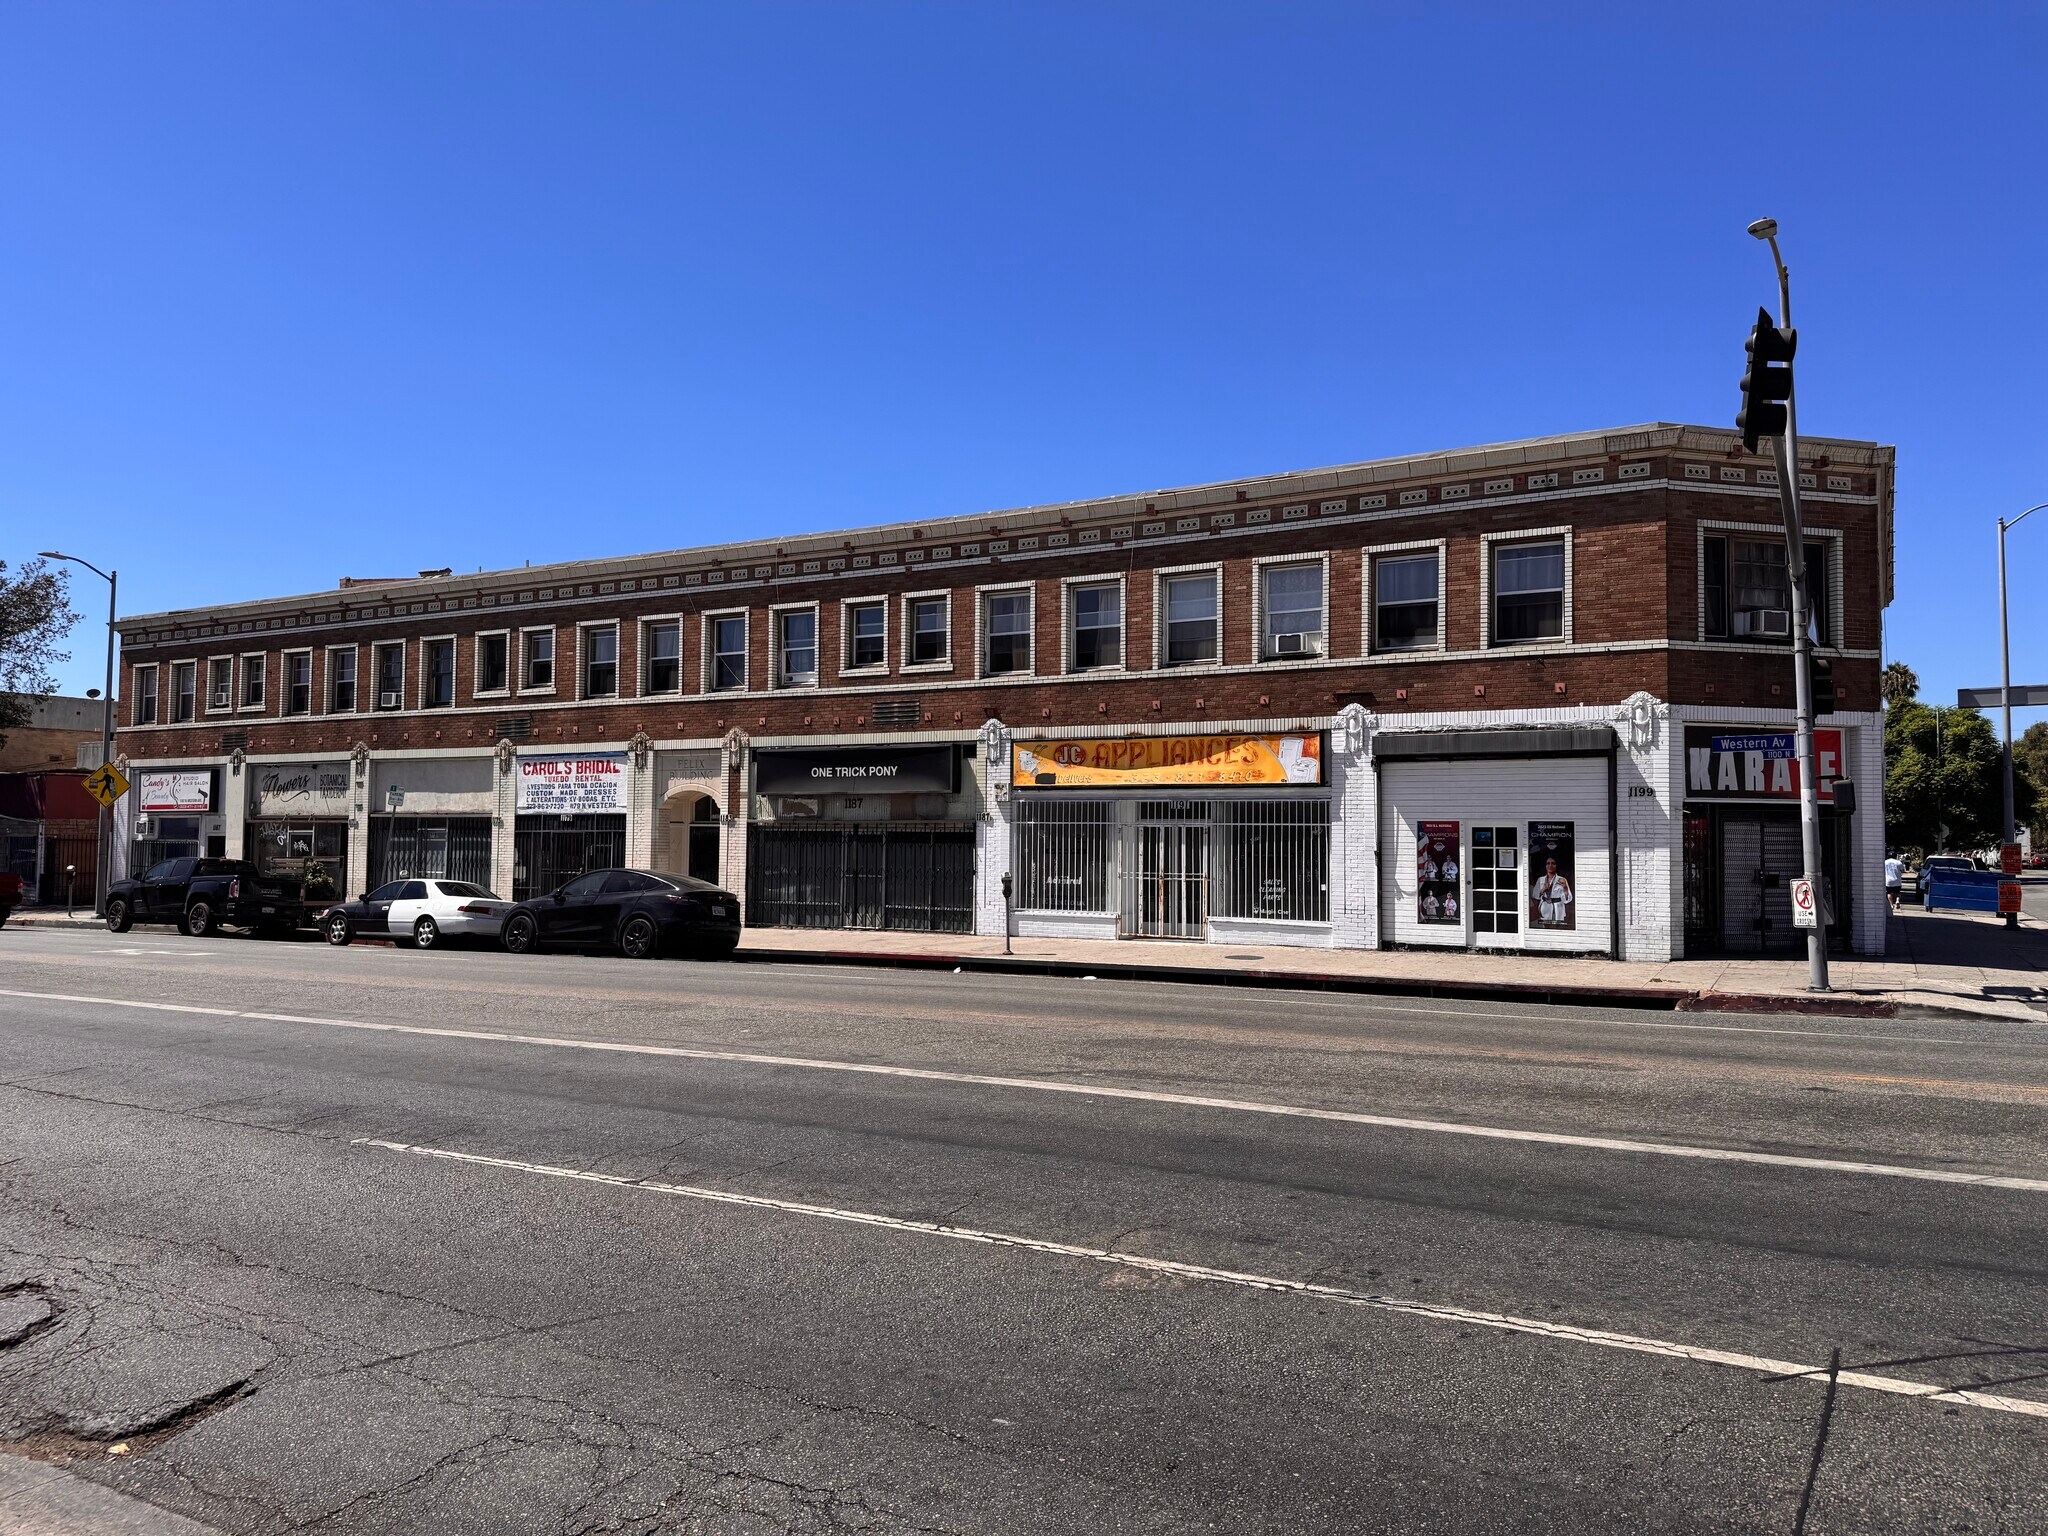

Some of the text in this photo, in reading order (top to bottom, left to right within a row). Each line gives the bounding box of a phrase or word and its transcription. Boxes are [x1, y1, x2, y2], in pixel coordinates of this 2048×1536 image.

[1720, 737, 1786, 750] Western Av
[1058, 737, 1258, 768] JC APPLIANCES
[1767, 750, 1790, 759] 1100 N
[522, 759, 621, 776] CAROL'S BRIDAL
[677, 759, 705, 769] FELIX
[669, 770, 714, 781] BUILDING
[811, 766, 898, 778] ONE TRICK PONY
[1690, 747, 1836, 793] KARAE
[143, 774, 170, 791] Candy's
[320, 773, 348, 787] BOTANICAL
[261, 772, 311, 804] Flowers
[320, 787, 348, 798] TAXIDERMY
[1628, 786, 1654, 797] 1199
[844, 798, 863, 809] 1187
[1170, 800, 1190, 809] 1191
[976, 812, 990, 821] 1187
